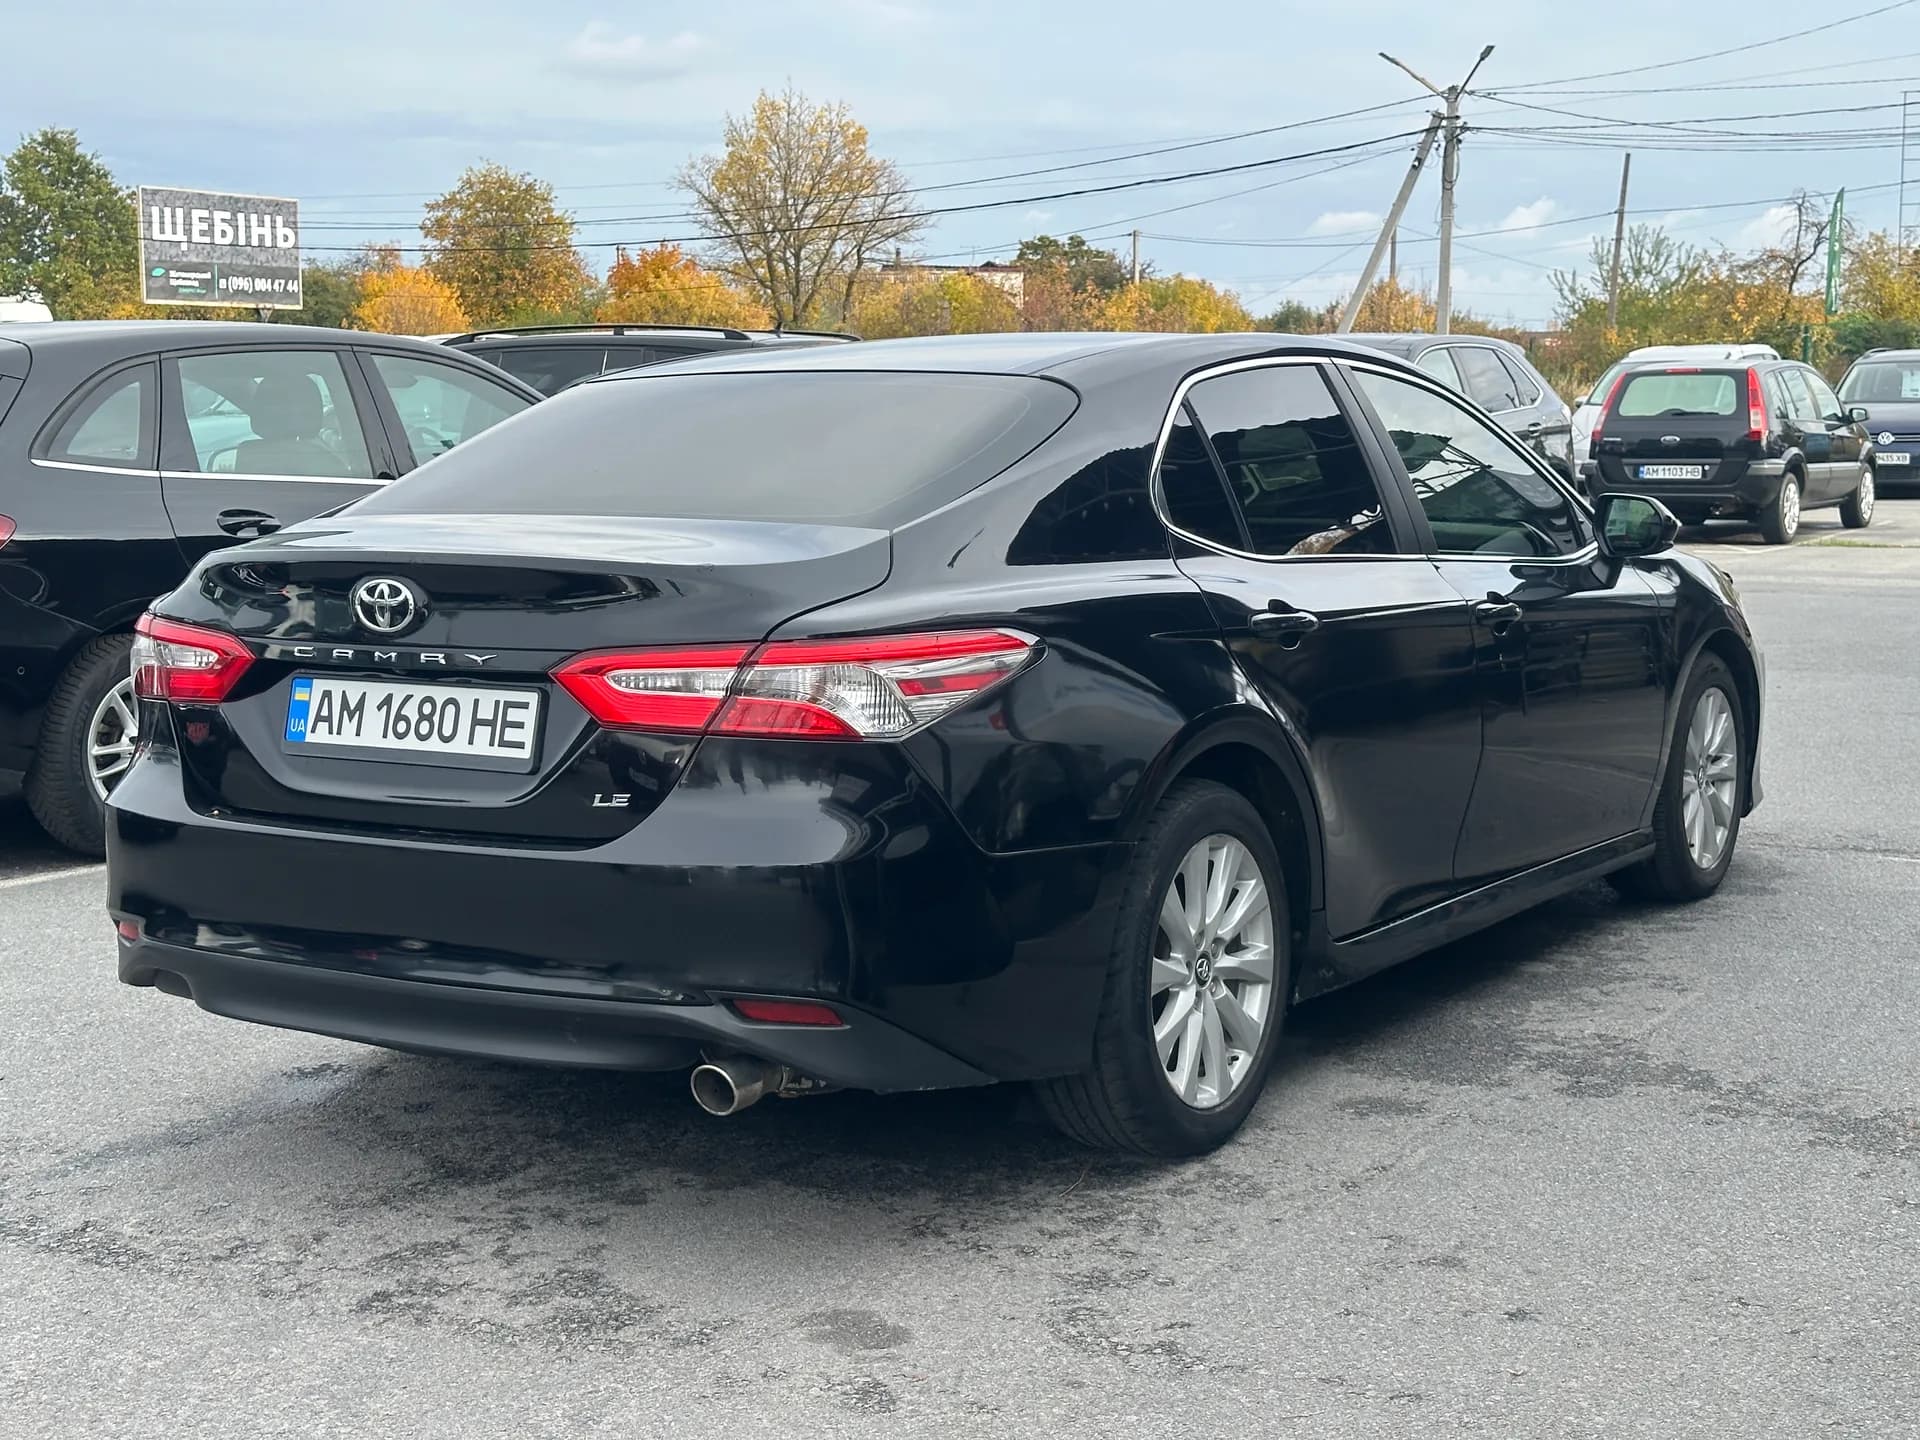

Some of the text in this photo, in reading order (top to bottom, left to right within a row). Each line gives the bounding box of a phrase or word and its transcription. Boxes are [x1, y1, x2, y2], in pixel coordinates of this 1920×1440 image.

[151, 206, 296, 251] ЩЕБІНЬ
[1645, 466, 1659, 477] AM
[1661, 466, 1684, 477] 1103
[293, 646, 497, 665] CAMRY
[290, 718, 305, 733] UA
[310, 689, 530, 750] AM 1680 HE
[592, 793, 632, 807] LE
